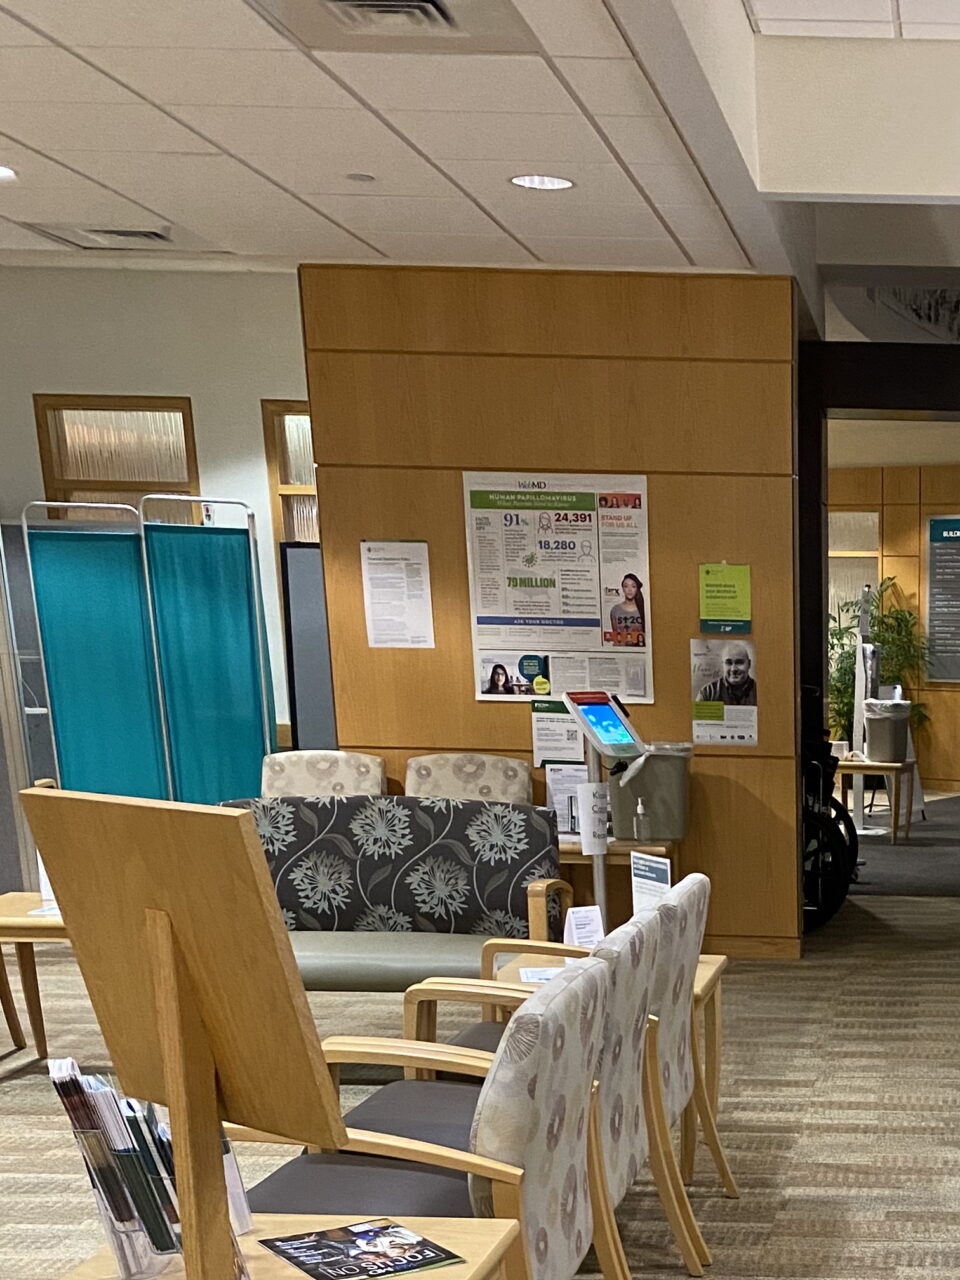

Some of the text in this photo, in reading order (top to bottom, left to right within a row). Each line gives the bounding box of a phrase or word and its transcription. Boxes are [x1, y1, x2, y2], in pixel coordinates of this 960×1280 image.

[517, 494, 577, 502] PAPILLOMAVIRUS
[554, 512, 592, 523] 24,391
[538, 540, 576, 551] 18,280
[506, 576, 518, 588] 79
[519, 576, 556, 589] MILLION
[360, 1248, 437, 1271] FOCUS
[330, 1265, 360, 1278] ON
